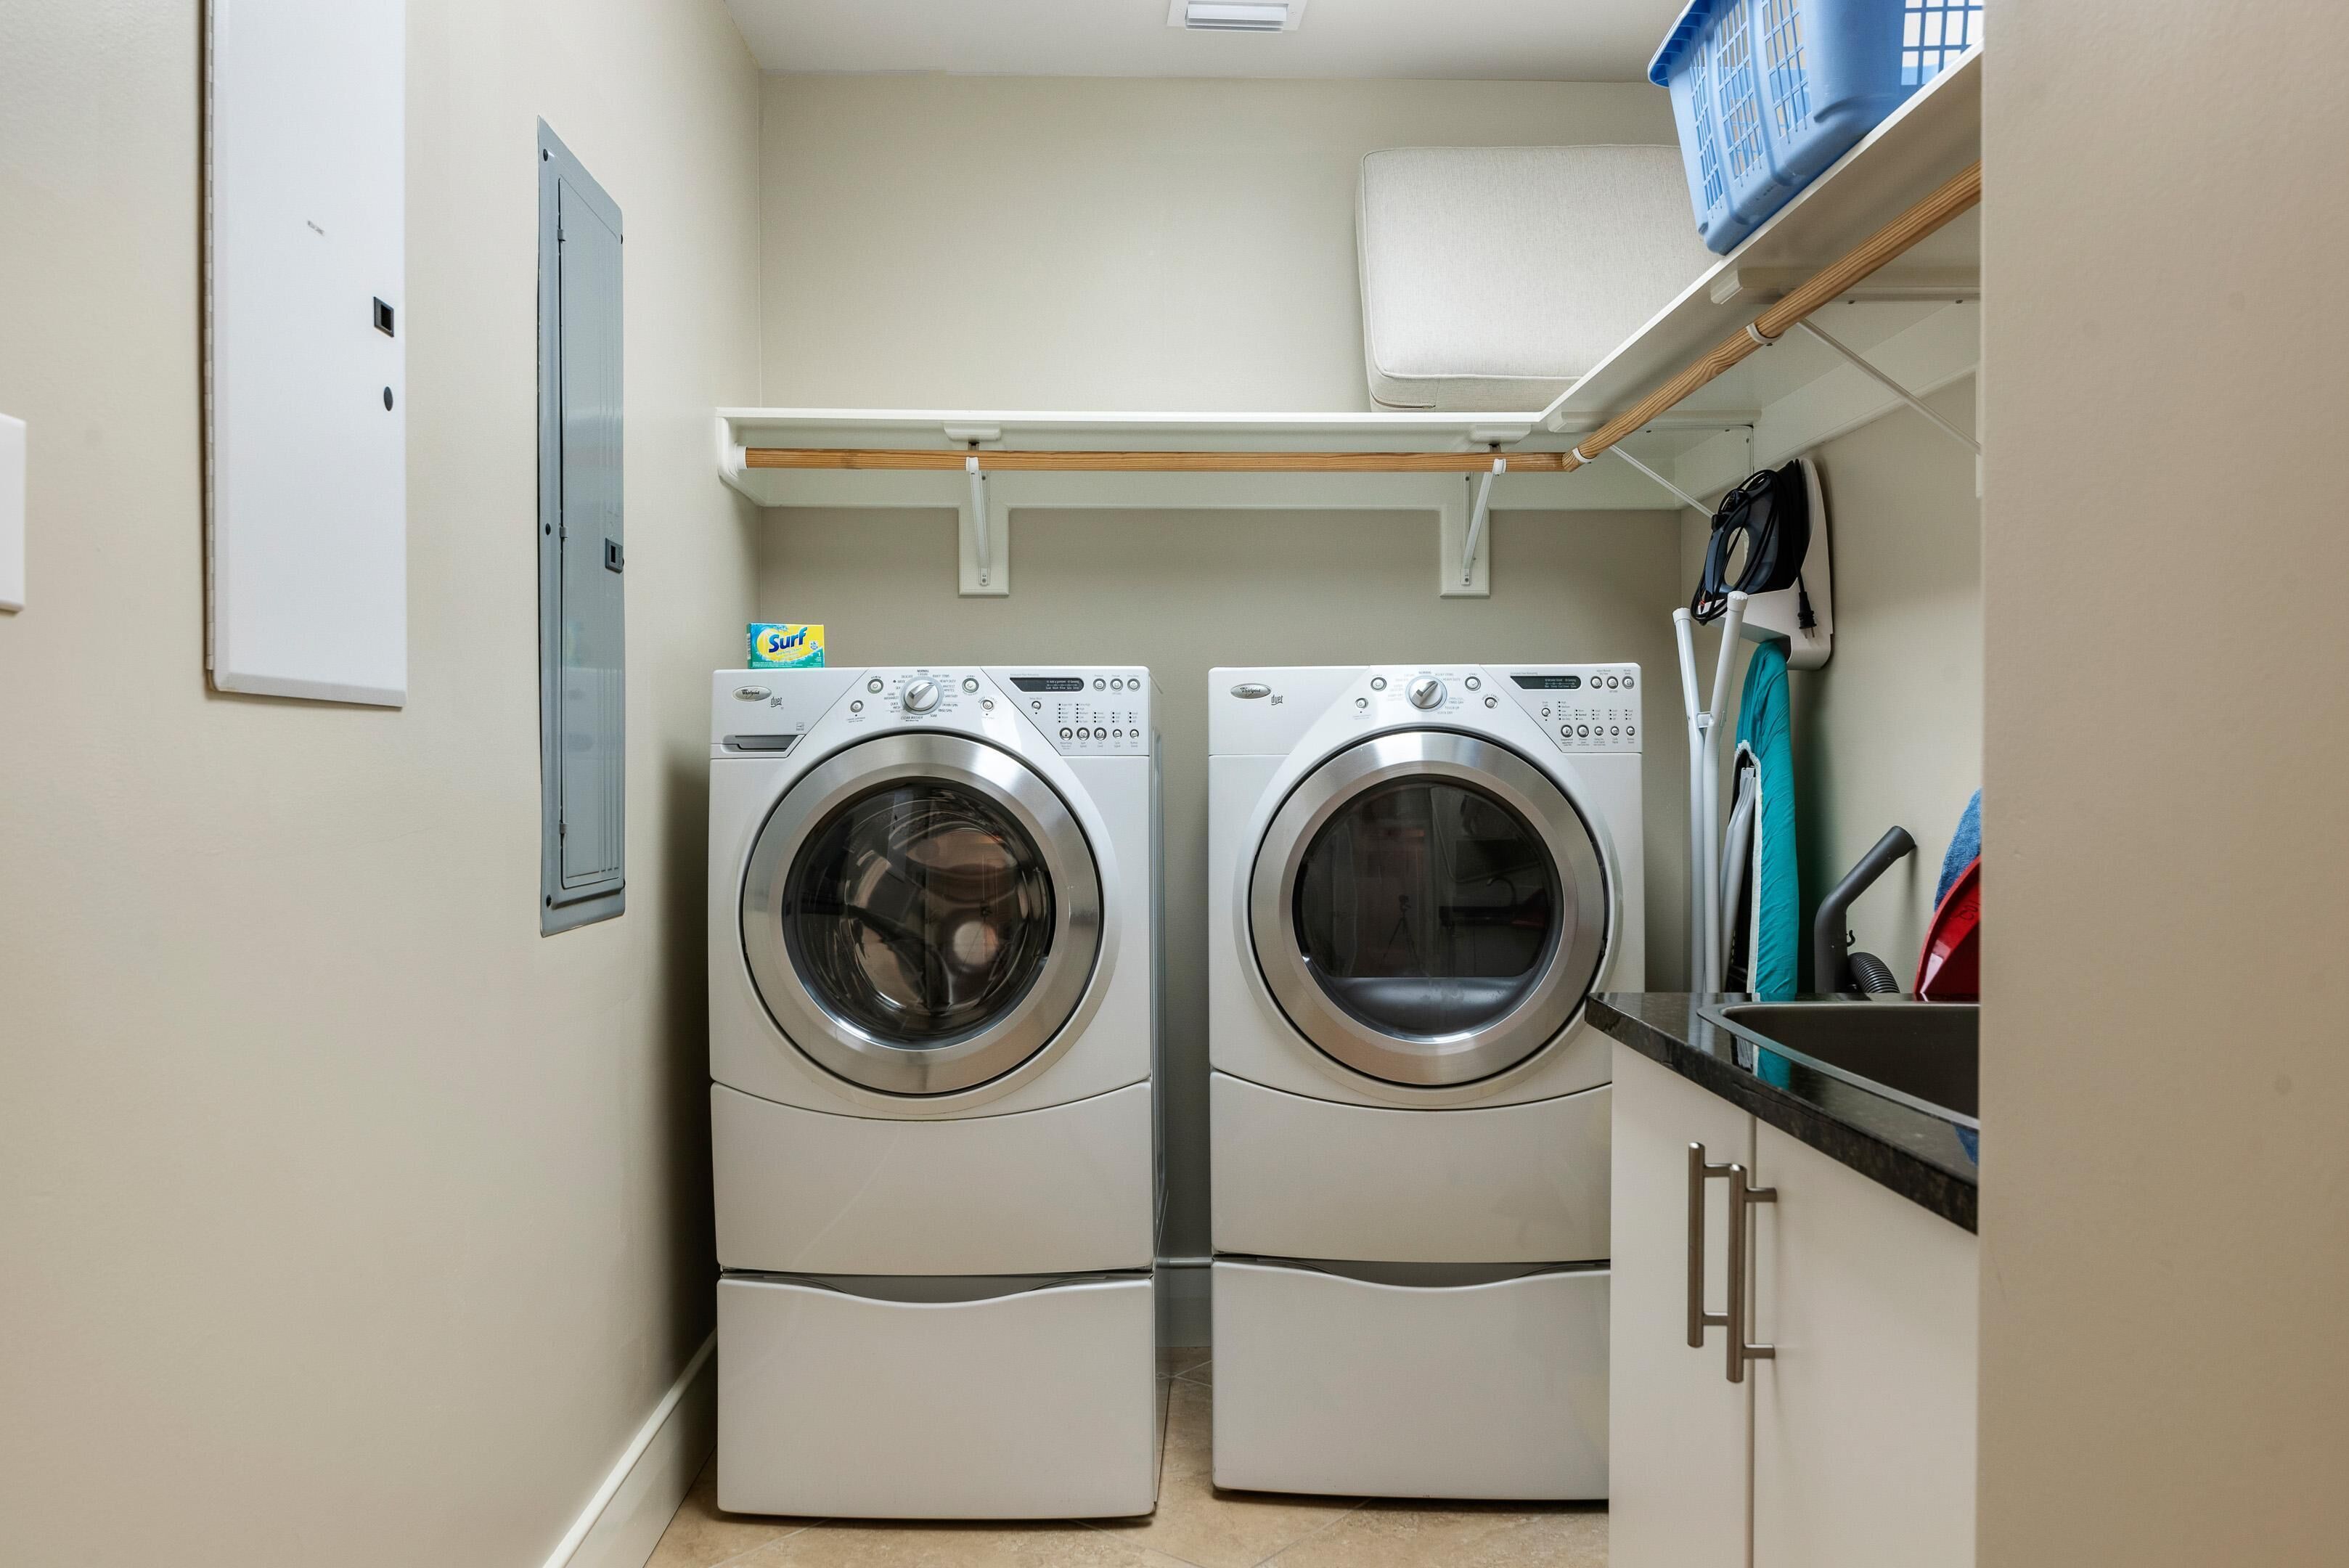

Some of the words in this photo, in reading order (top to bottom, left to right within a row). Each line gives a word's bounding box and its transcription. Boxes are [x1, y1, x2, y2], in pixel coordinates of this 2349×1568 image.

[769, 627, 807, 653] Surf
[770, 697, 783, 708] duet
[1271, 695, 1283, 706] duet
